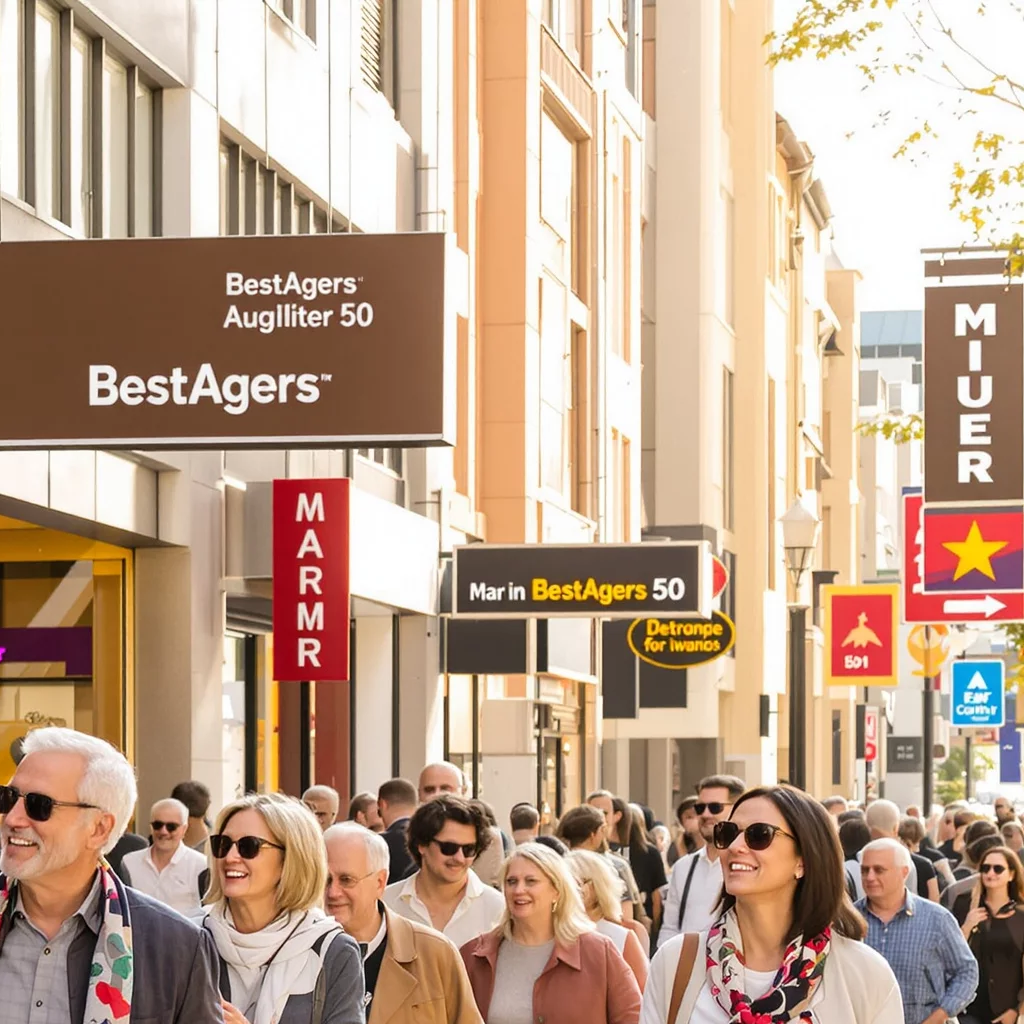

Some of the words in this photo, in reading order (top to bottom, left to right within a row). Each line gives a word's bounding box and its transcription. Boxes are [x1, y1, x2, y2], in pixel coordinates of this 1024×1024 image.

[225, 271, 358, 300] BestAgers
[339, 302, 374, 328] 50
[88, 363, 321, 415] BestAgers
[954, 302, 997, 484] MIUER
[295, 492, 326, 668] MARMR
[531, 578, 648, 605] BestAgers
[651, 577, 686, 601] 50
